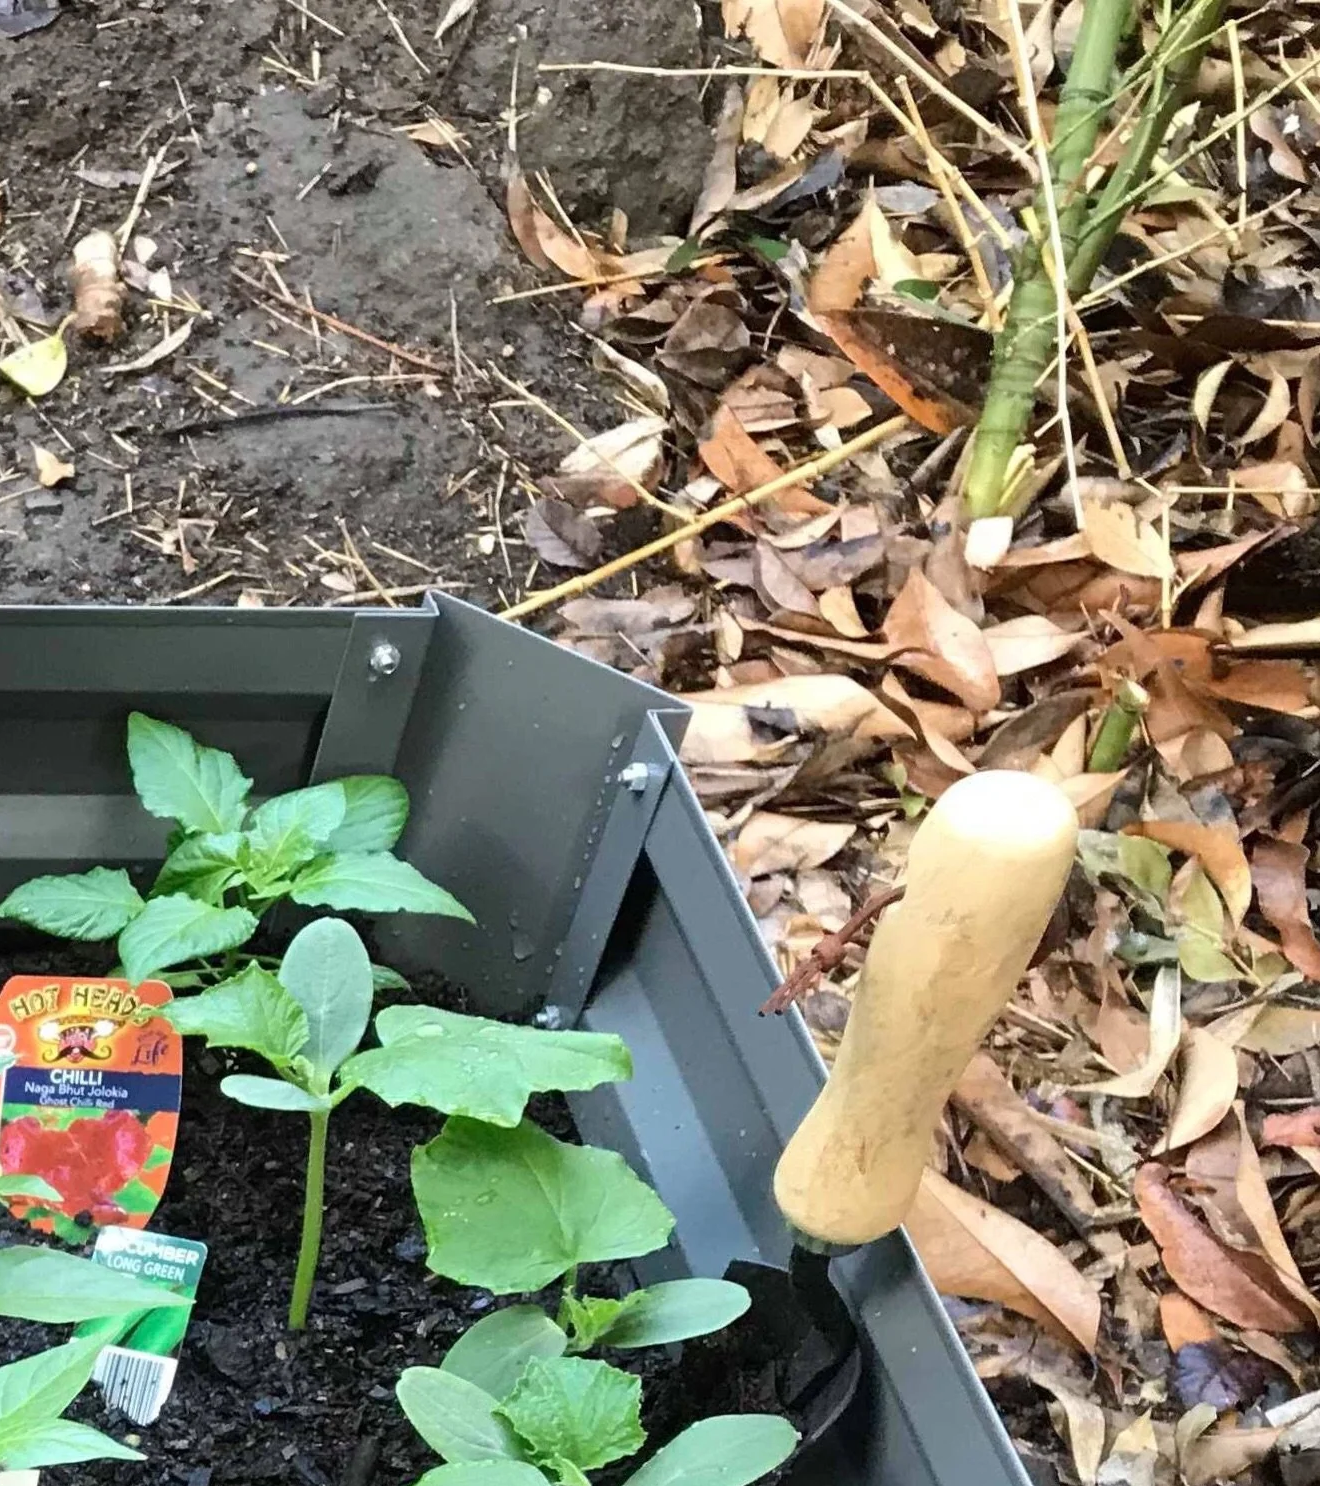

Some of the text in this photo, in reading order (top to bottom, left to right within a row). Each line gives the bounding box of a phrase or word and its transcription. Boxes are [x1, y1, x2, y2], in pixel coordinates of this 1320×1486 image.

[10, 985, 60, 1020] HOT
[49, 1068, 102, 1086] CHILLI
[24, 1081, 128, 1099] Naga Bhut Jolokia
[107, 1254, 186, 1282] LONG GREEN
